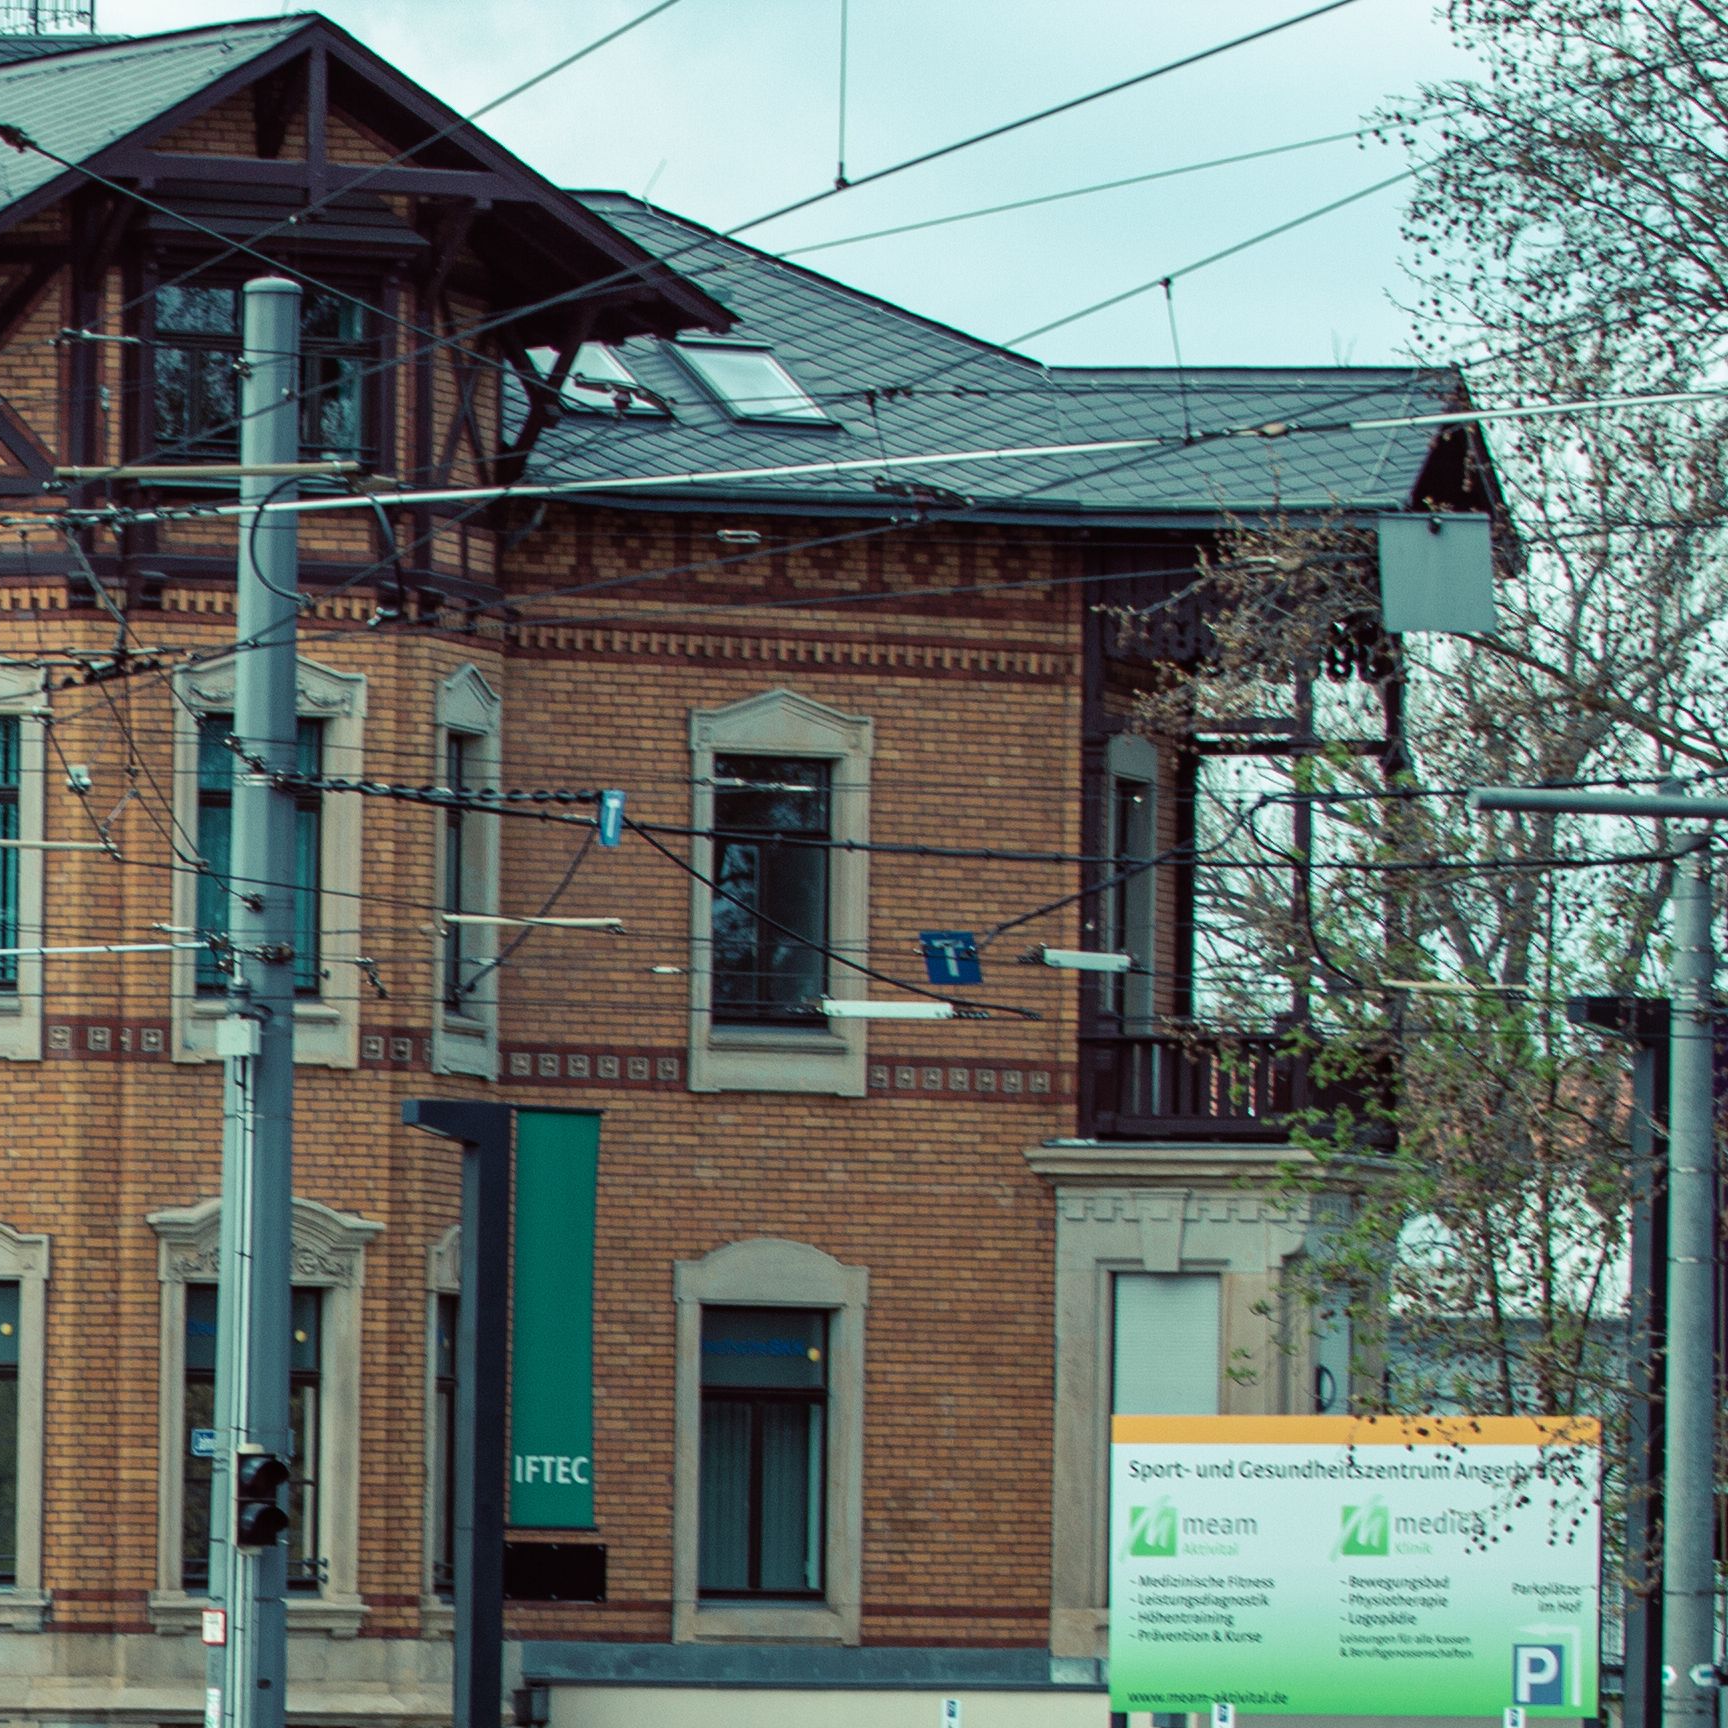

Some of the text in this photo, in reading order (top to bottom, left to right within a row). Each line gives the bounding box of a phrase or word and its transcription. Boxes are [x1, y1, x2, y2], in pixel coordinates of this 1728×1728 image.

[931, 939, 965, 977] T
[514, 1454, 590, 1485] IFTEC
[1128, 1460, 1192, 1482] Sport-
[1196, 1459, 1235, 1479] und
[1238, 1460, 1451, 1481] Gesundheitszentrum
[1181, 1516, 1259, 1536] meam
[1395, 1512, 1486, 1536] medica
[1138, 1575, 1275, 1589] Medizinische Fitness
[1348, 1575, 1450, 1591] Bewegungsbad
[1138, 1593, 1270, 1609] Leistungsdiagnostik
[1348, 1593, 1449, 1610] Physiotherapie
[1558, 1599, 1582, 1613] Hof
[1138, 1611, 1235, 1627] Höhentraining
[1348, 1611, 1417, 1627] Logopädie
[1138, 1629, 1263, 1643] Prävention & Kurse
[1516, 1647, 1558, 1703] P
